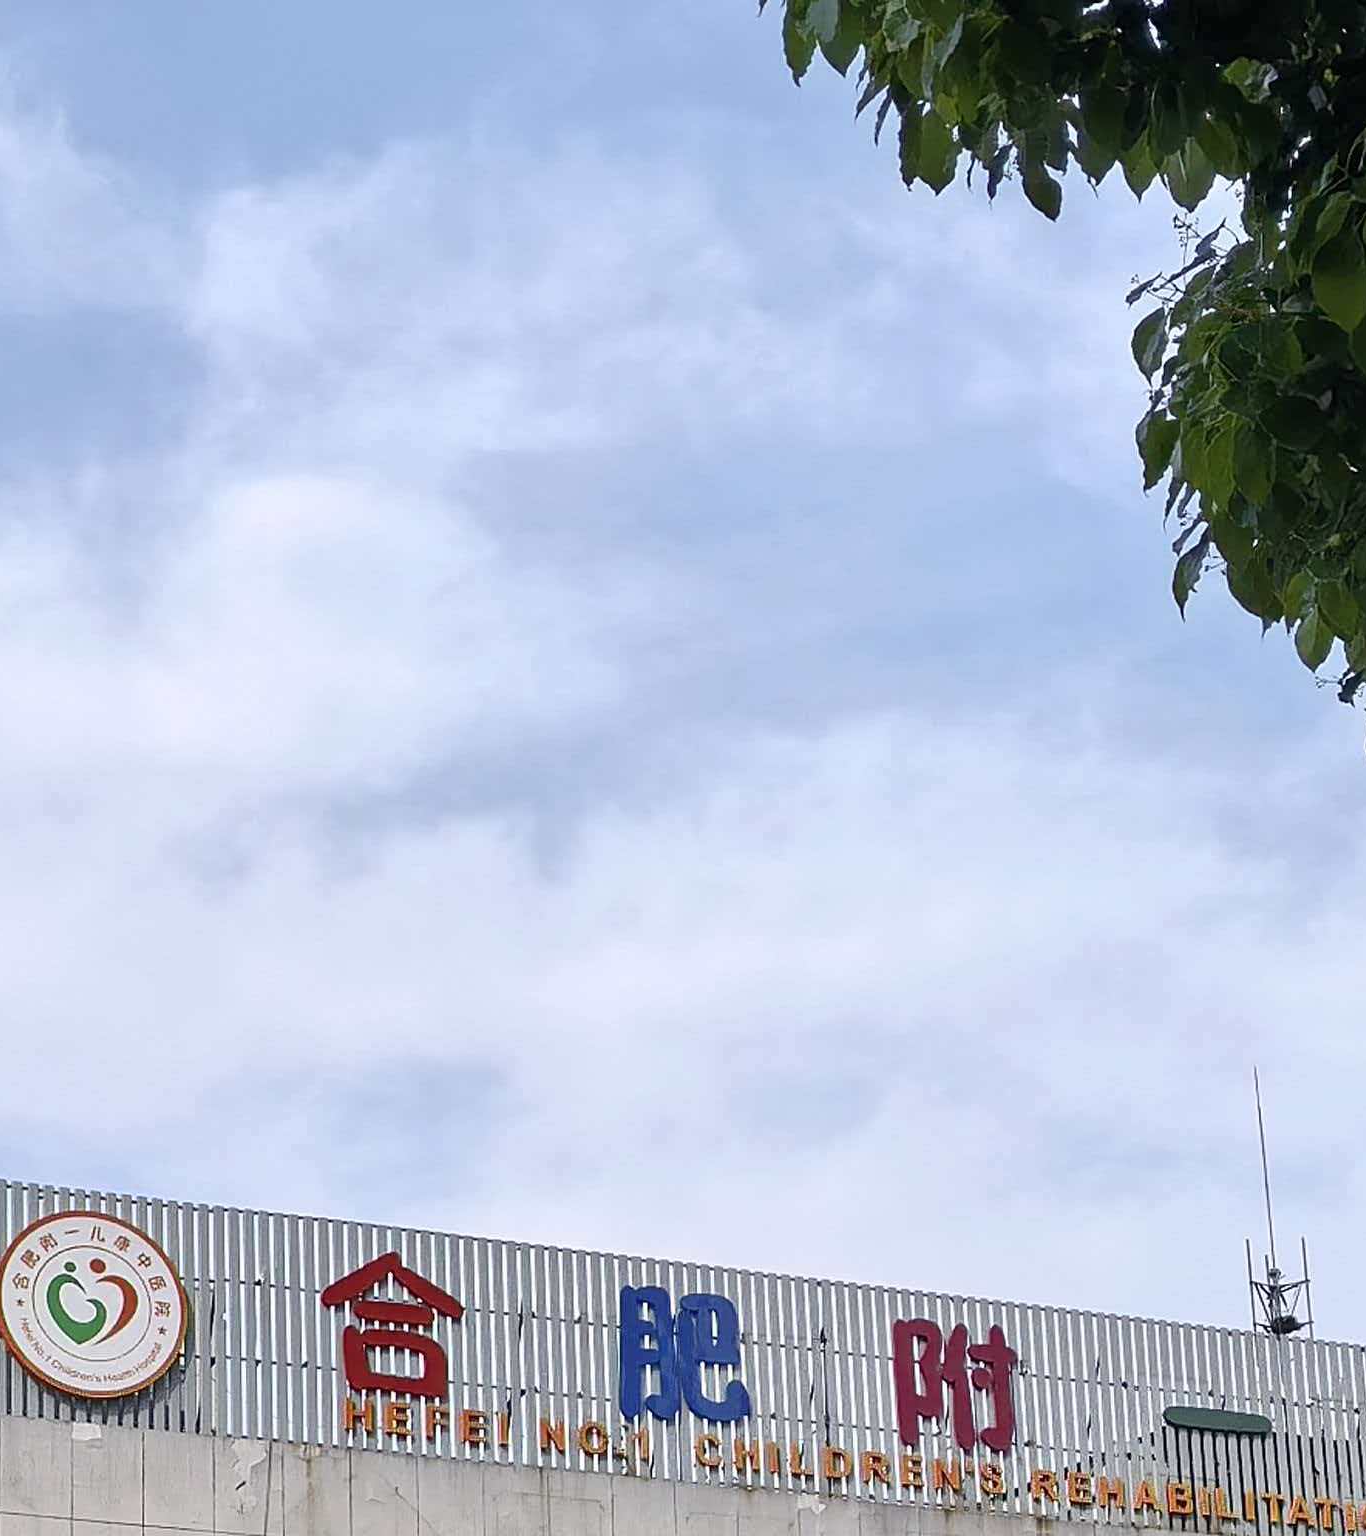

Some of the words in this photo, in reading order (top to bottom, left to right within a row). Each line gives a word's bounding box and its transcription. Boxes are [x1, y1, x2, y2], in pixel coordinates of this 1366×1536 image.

[341, 1397, 512, 1446] HEFEI
[540, 1418, 650, 1462] NO.1
[694, 1433, 1006, 1495] CHILDREN'S
